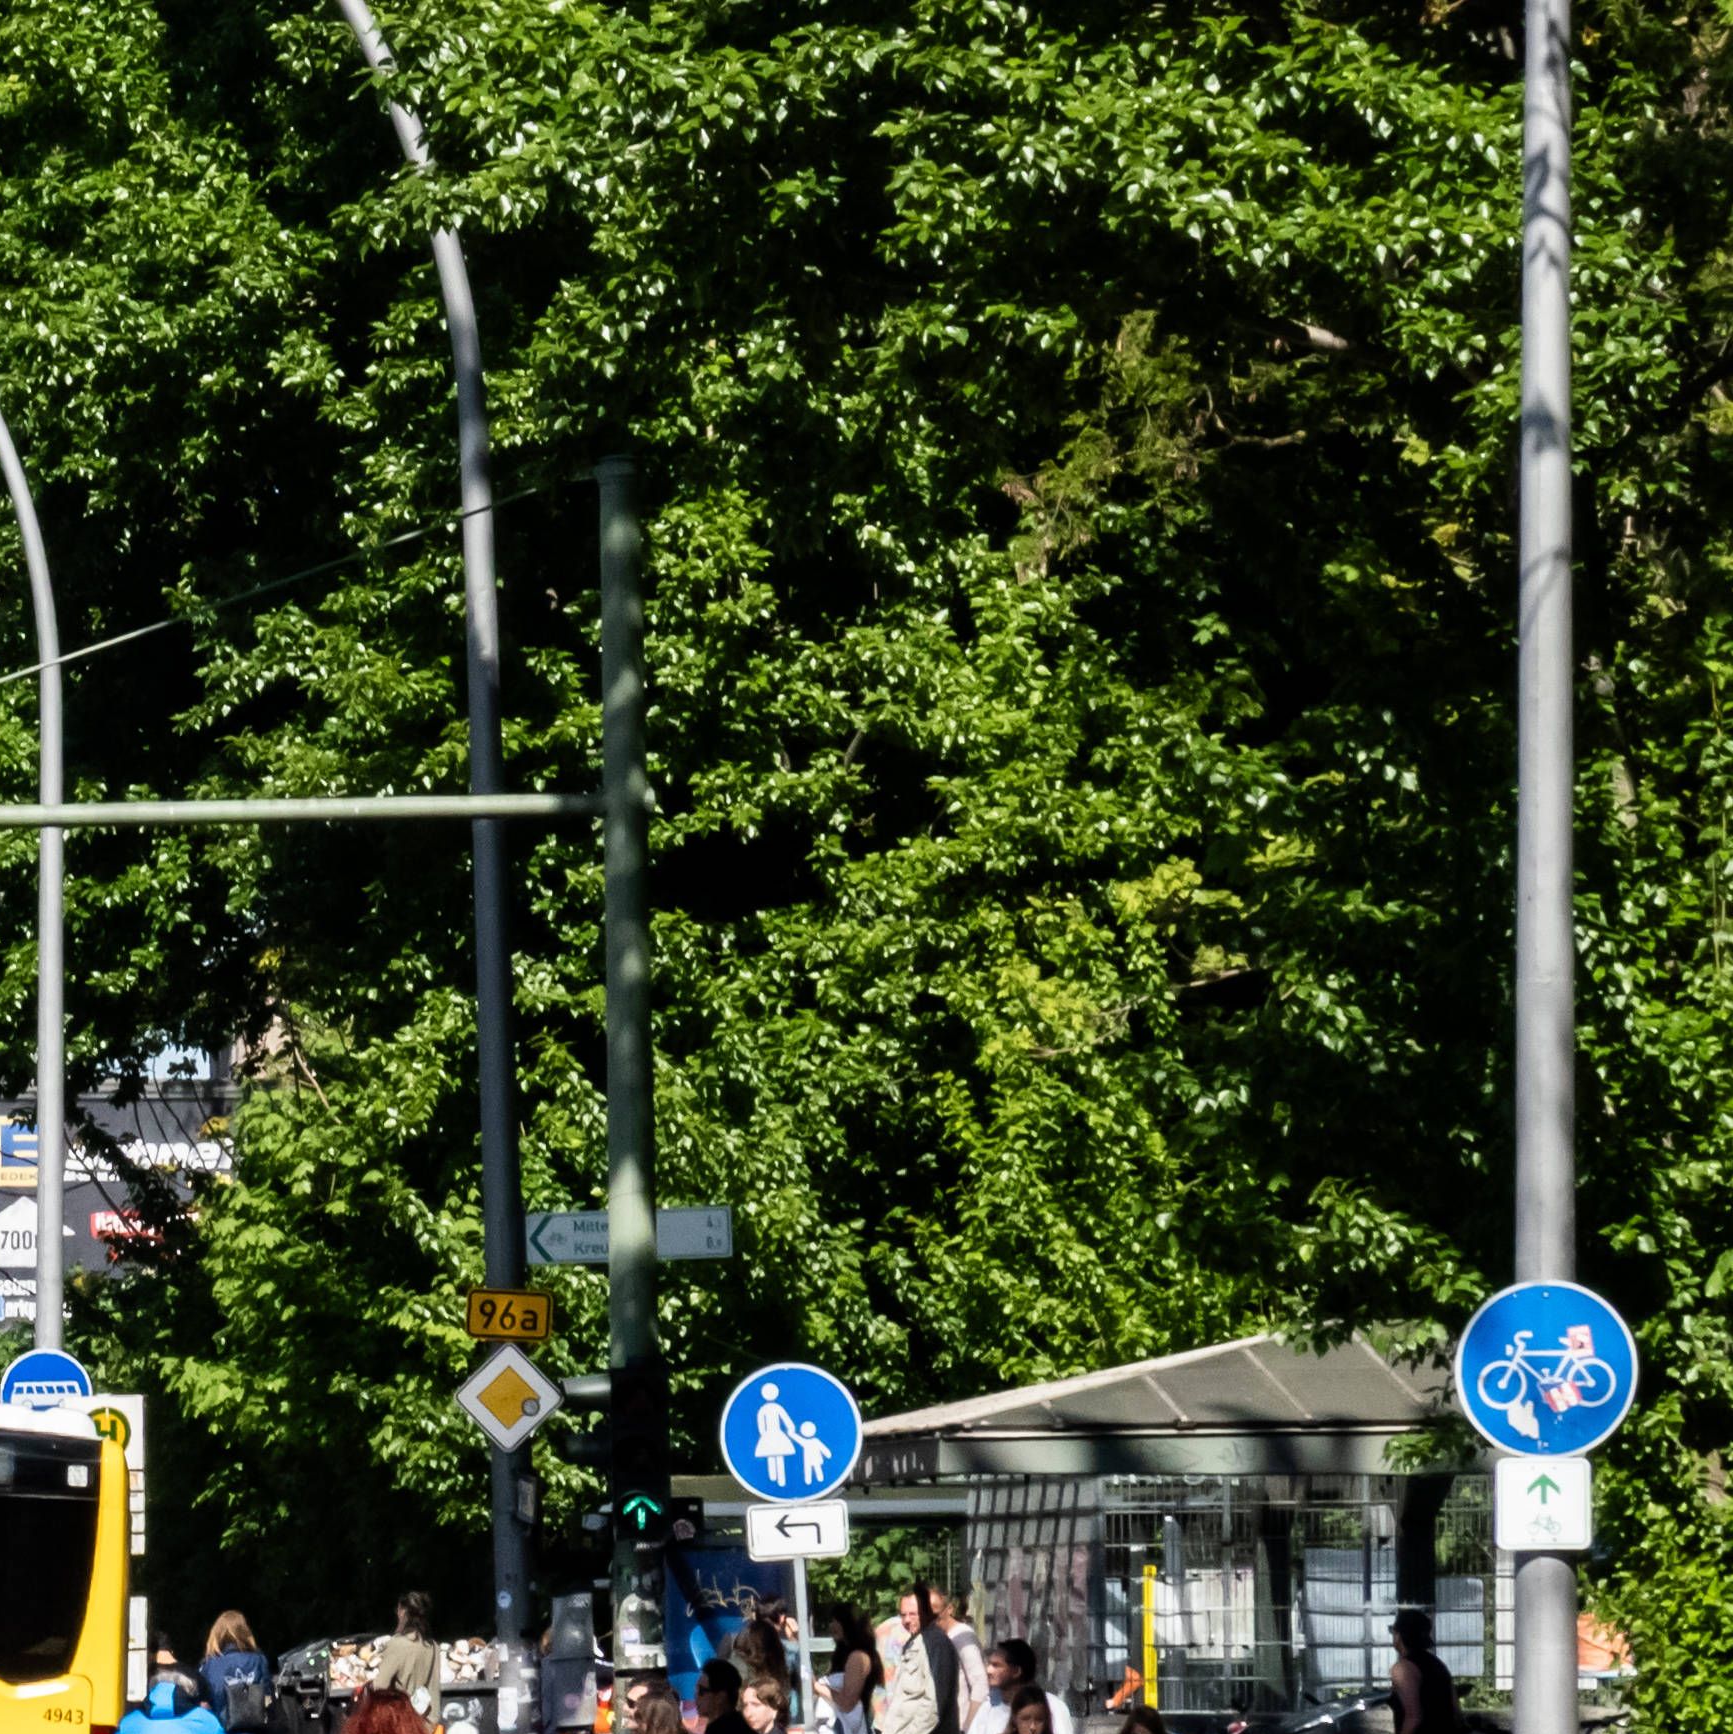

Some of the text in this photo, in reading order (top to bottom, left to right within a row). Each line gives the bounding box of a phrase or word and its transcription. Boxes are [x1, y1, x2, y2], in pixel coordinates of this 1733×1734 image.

[0, 1171, 38, 1182] EDEK
[478, 1299, 538, 1331] 96a
[43, 1707, 84, 1725] 4943
